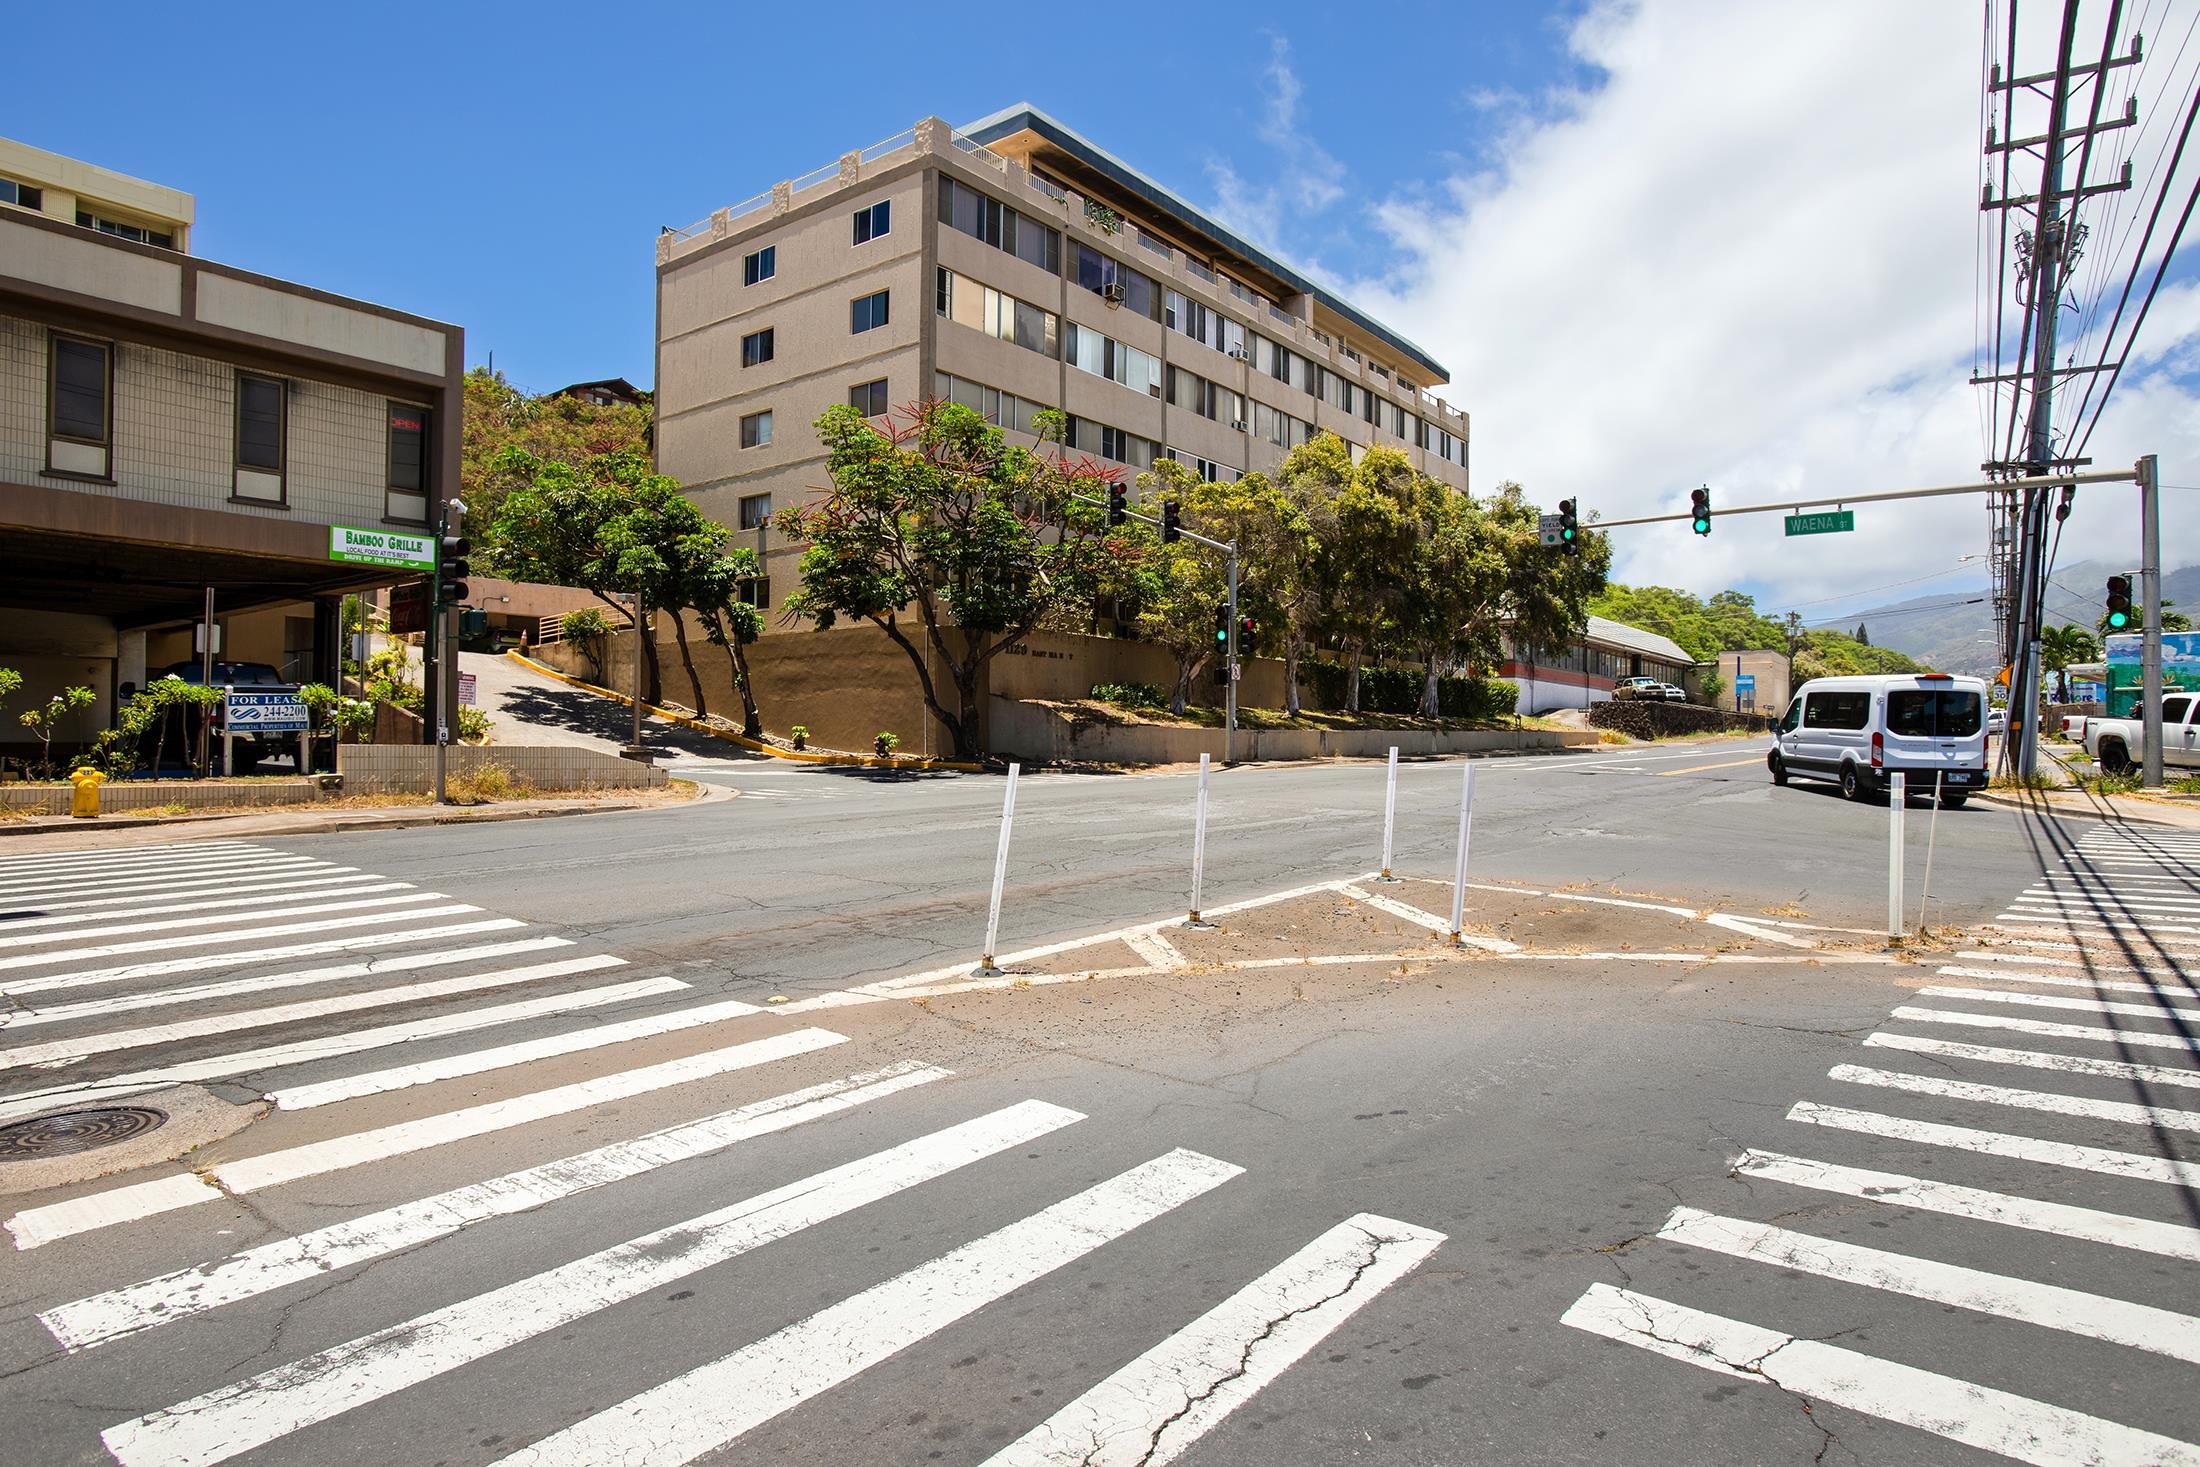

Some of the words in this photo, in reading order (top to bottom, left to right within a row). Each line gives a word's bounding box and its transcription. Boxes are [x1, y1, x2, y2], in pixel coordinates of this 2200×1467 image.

[1791, 517, 1834, 532] WAENA
[346, 531, 384, 547] BAMBOO
[388, 536, 422, 552] GRILLE
[231, 696, 258, 705] FOR
[263, 706, 306, 717] 244-2200
